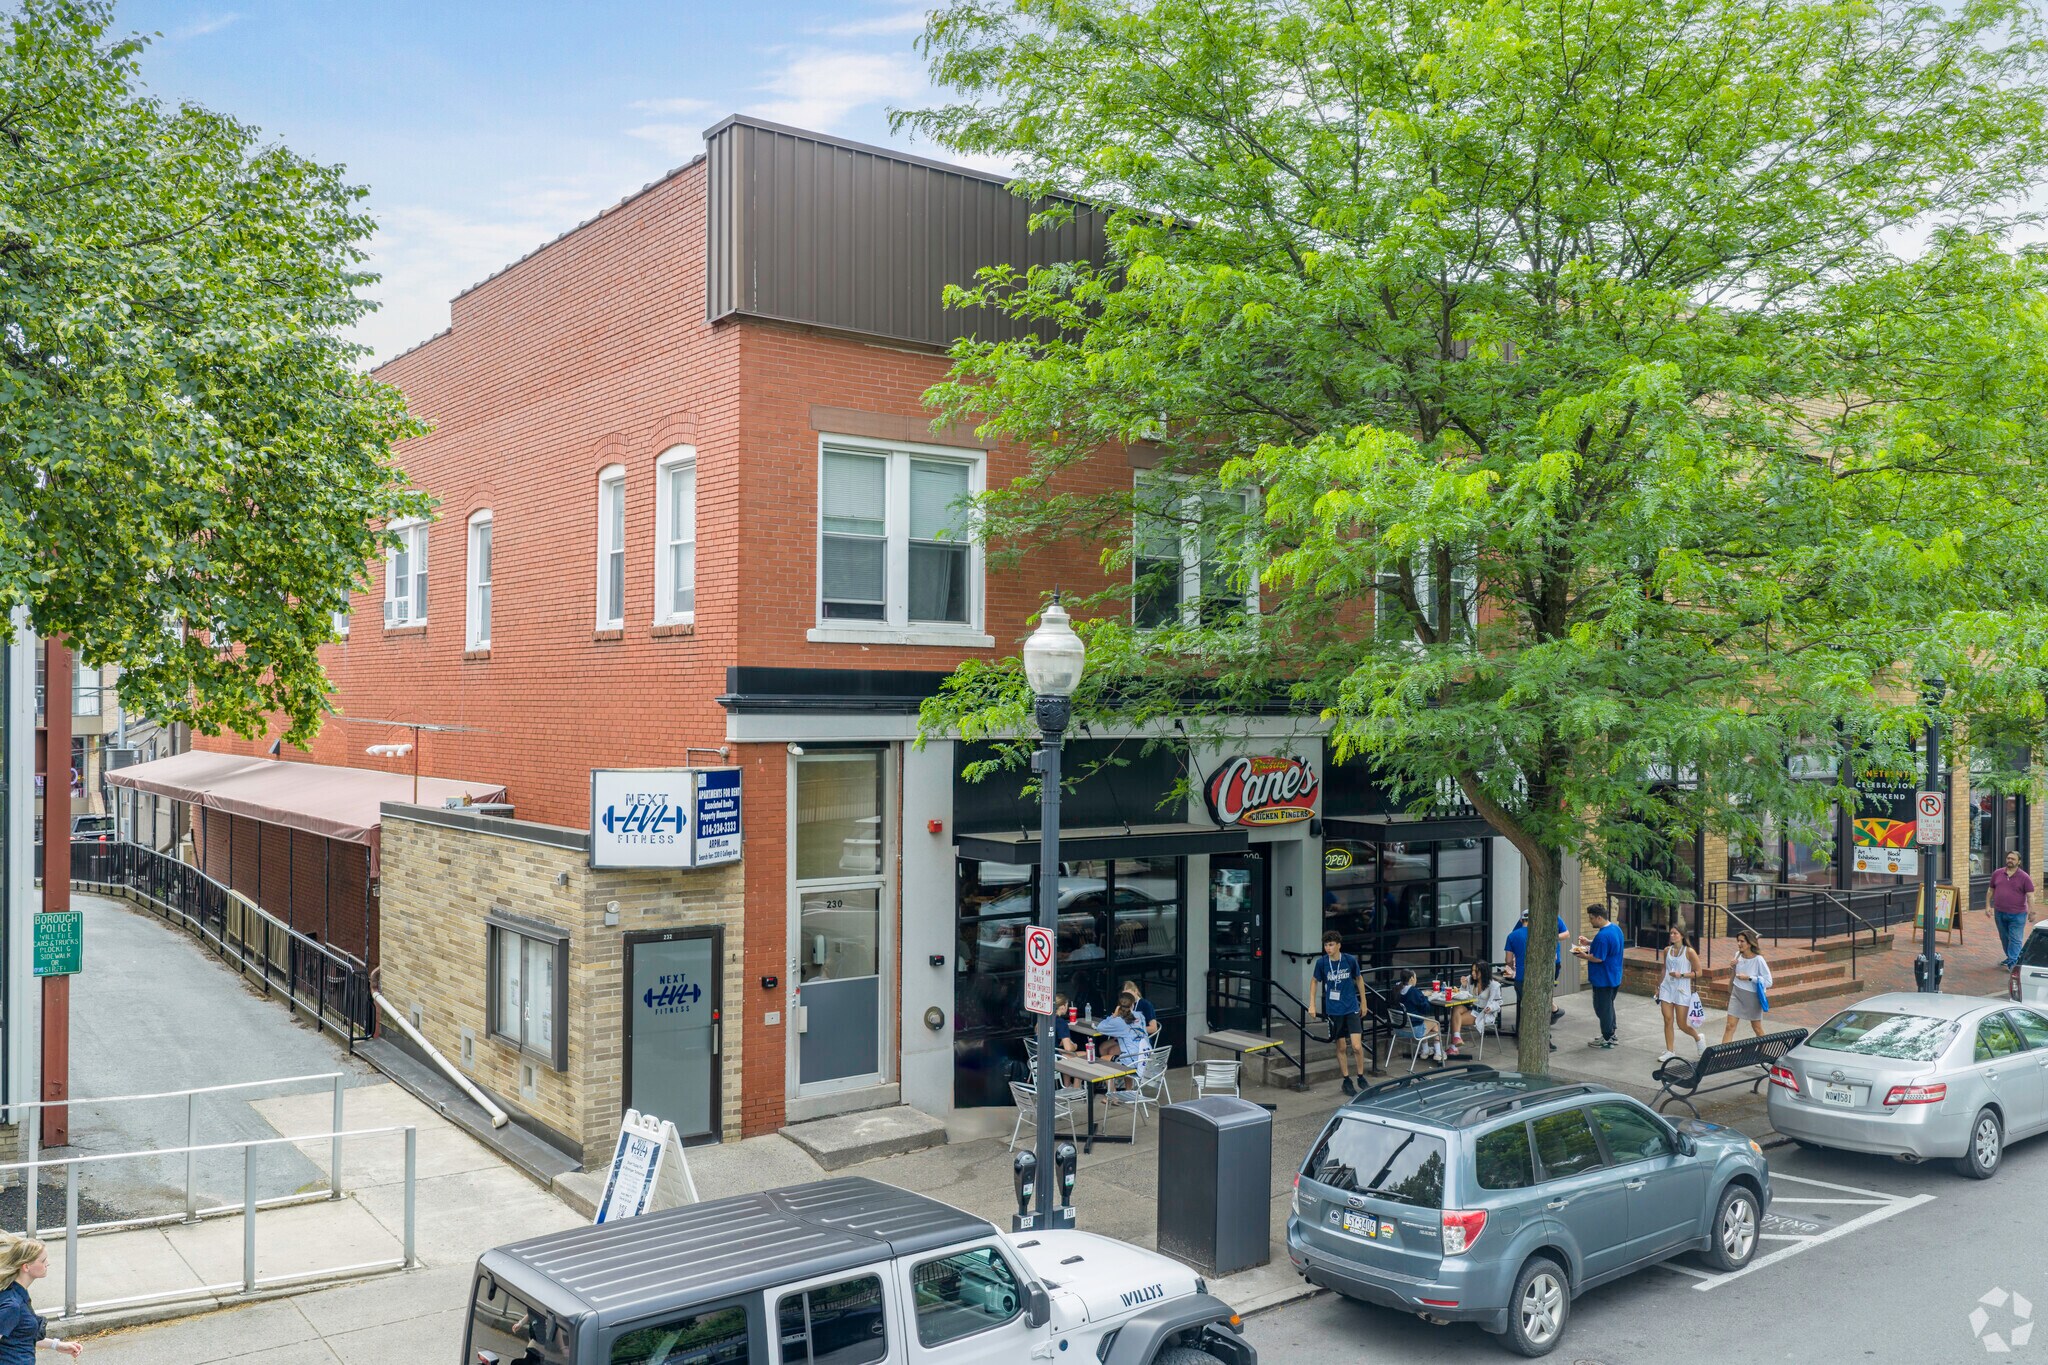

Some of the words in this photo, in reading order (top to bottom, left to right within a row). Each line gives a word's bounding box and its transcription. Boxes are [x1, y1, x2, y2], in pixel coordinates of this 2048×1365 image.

[1217, 756, 1319, 823] Cane's
[626, 794, 668, 806] NEXT
[622, 804, 668, 833] LVL
[1251, 812, 1279, 820] CHICKEN
[1281, 810, 1309, 819] FINGERS
[702, 821, 736, 836] 814-234-3333
[618, 835, 674, 844] FITNESS
[1325, 854, 1349, 866] OPEN
[826, 900, 842, 908] 230
[34, 914, 78, 924] BOROUGH
[40, 923, 72, 933] POLICE
[660, 974, 686, 984] NEXT
[658, 984, 688, 1006] LVL
[655, 1006, 689, 1015] FITNESS
[1120, 1284, 1163, 1307] WILLYS
